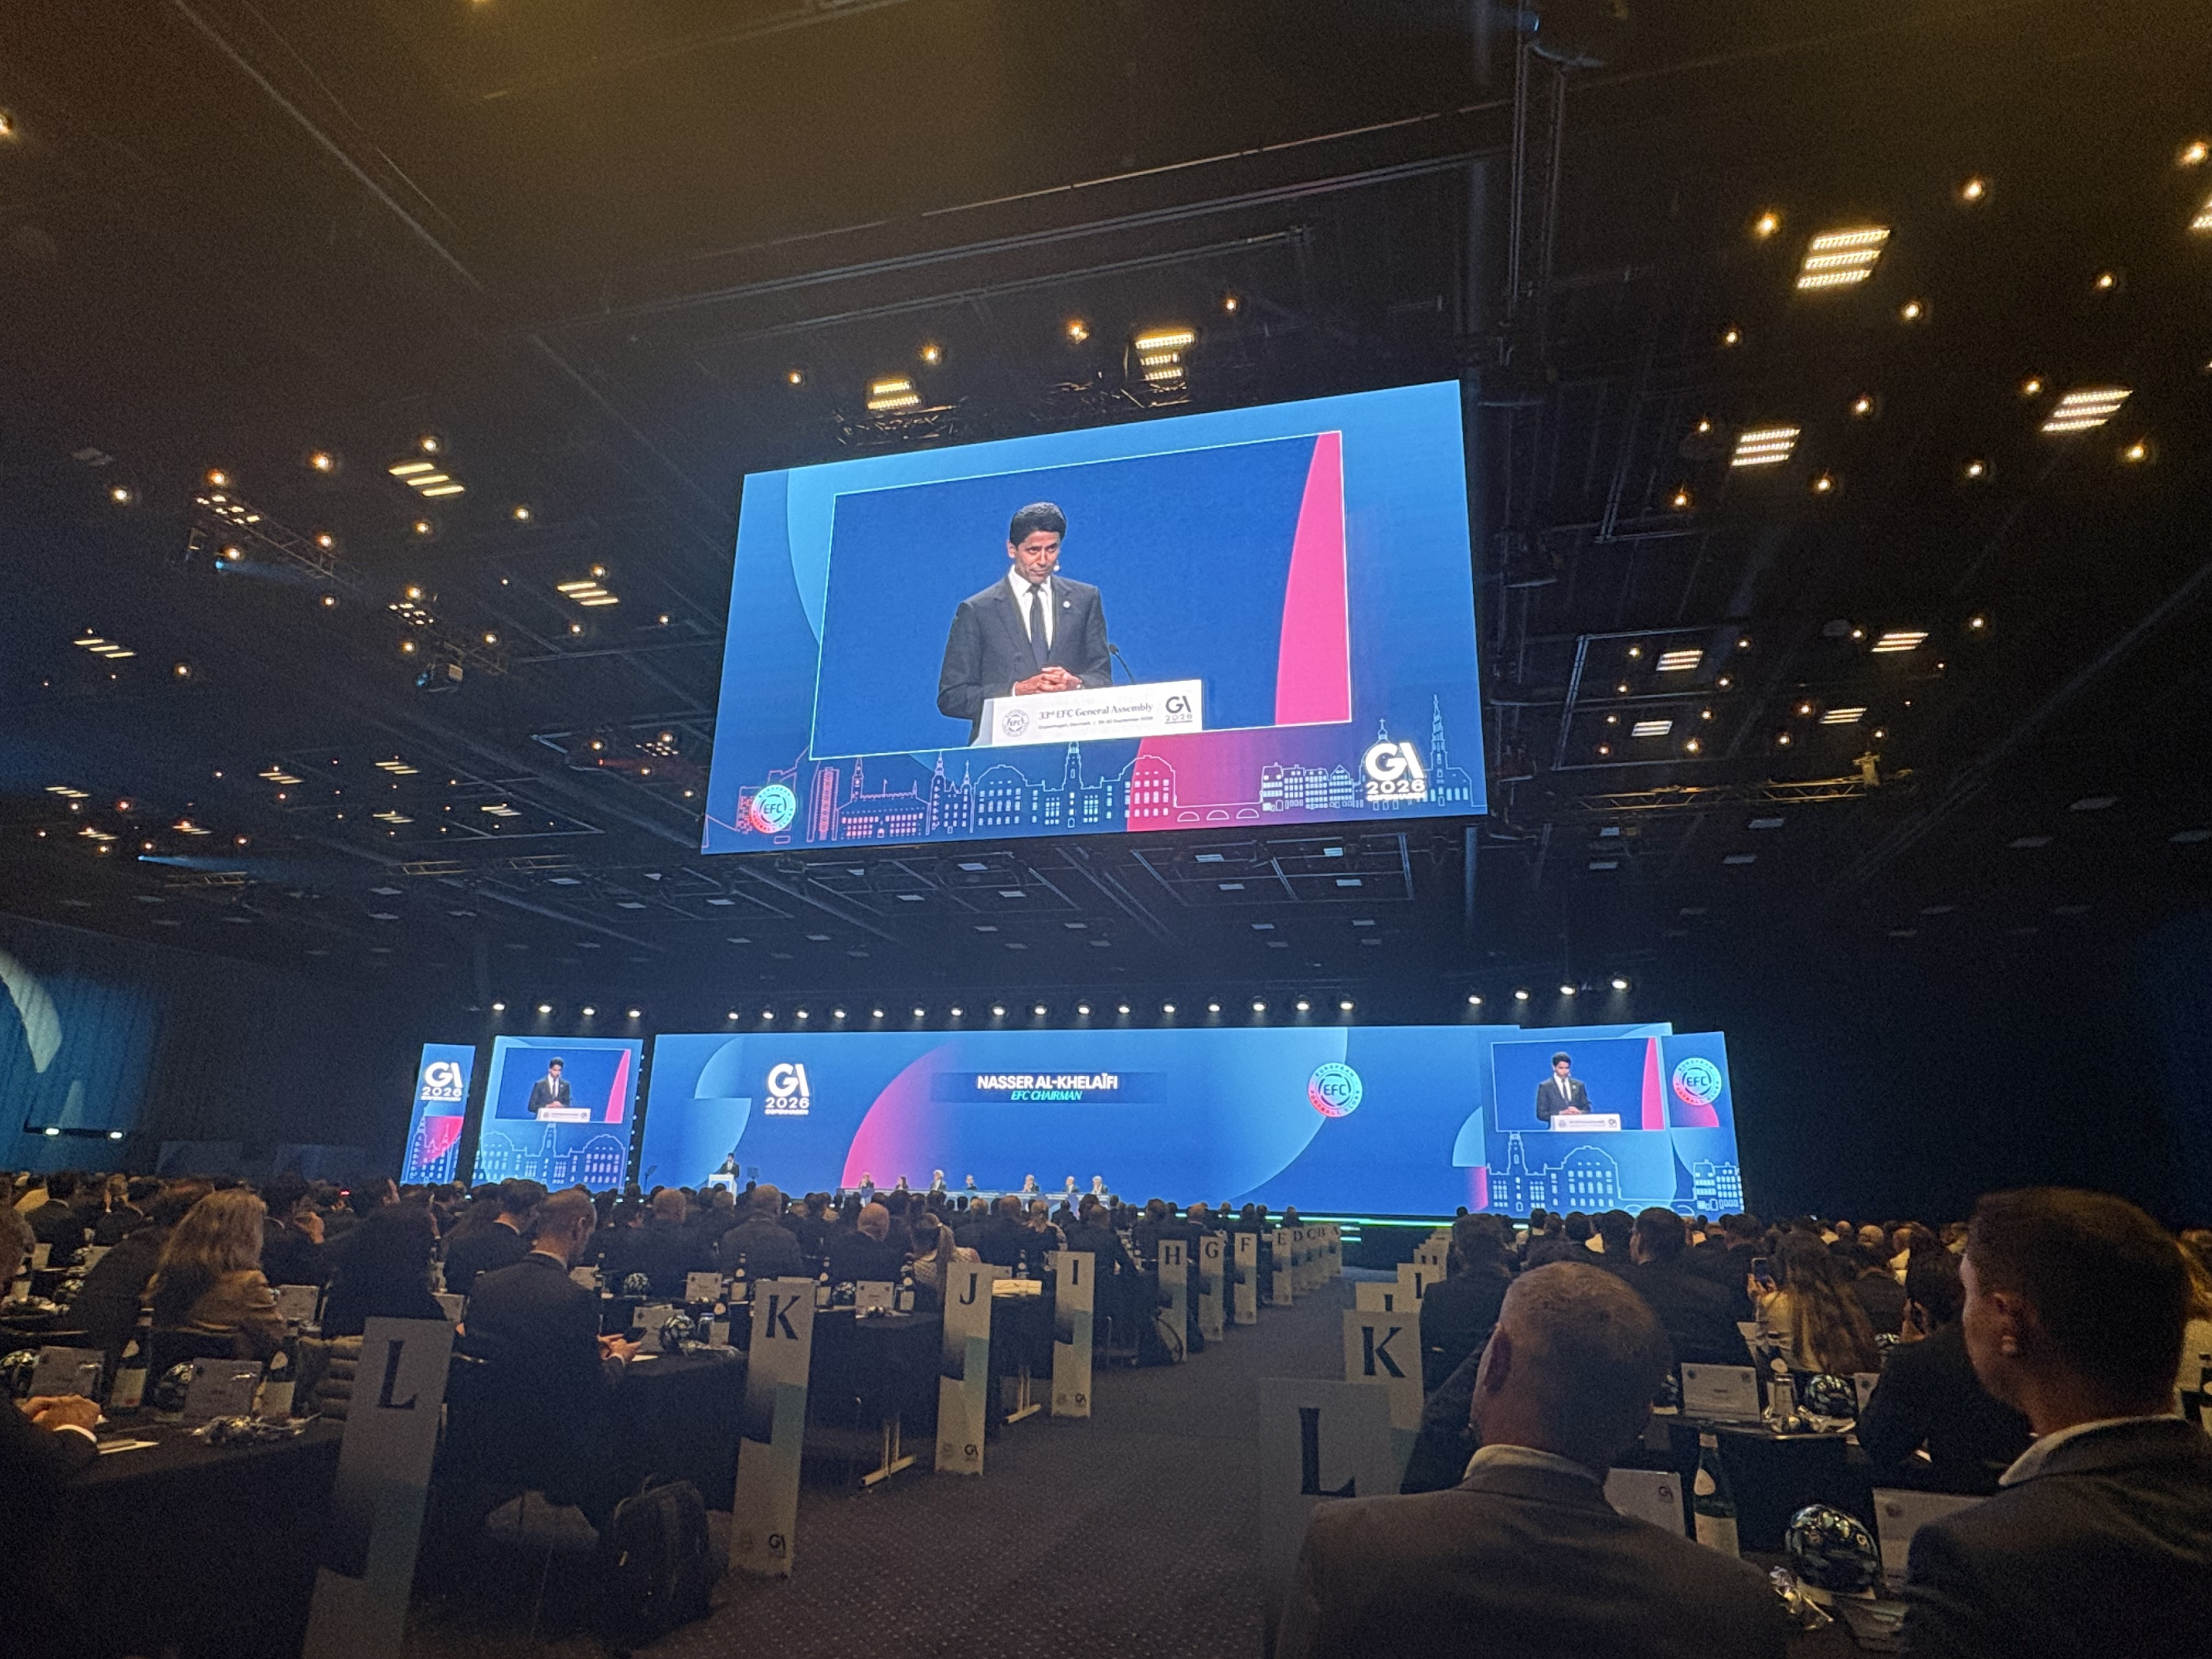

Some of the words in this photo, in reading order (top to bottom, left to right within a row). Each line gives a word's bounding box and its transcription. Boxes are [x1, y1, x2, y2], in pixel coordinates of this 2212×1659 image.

[1057, 708, 1073, 718] EFC
[1075, 705, 1110, 717] General
[1111, 703, 1154, 714] Assembly
[1366, 780, 1426, 795] 2026
[763, 803, 783, 814] EFC
[977, 1076, 1034, 1089] NASSER
[1686, 1076, 1709, 1087] EFC
[422, 1086, 462, 1097] 2026
[1011, 1090, 1031, 1101] EFC
[1031, 1090, 1083, 1101] CHAIRMAN
[1323, 1083, 1347, 1096] EFC
[766, 1097, 809, 1109] 2026
[1294, 1231, 1303, 1242] D
[1307, 1228, 1315, 1239] C
[1318, 1227, 1326, 1237] B
[1241, 1237, 1251, 1253] F
[1278, 1233, 1286, 1245] E
[1165, 1246, 1180, 1265] H
[1205, 1241, 1218, 1258] G
[960, 1272, 977, 1305] J
[766, 1295, 800, 1340] K
[1362, 1326, 1406, 1378] K
[377, 1339, 418, 1408] L
[1298, 1407, 1356, 1497] L
